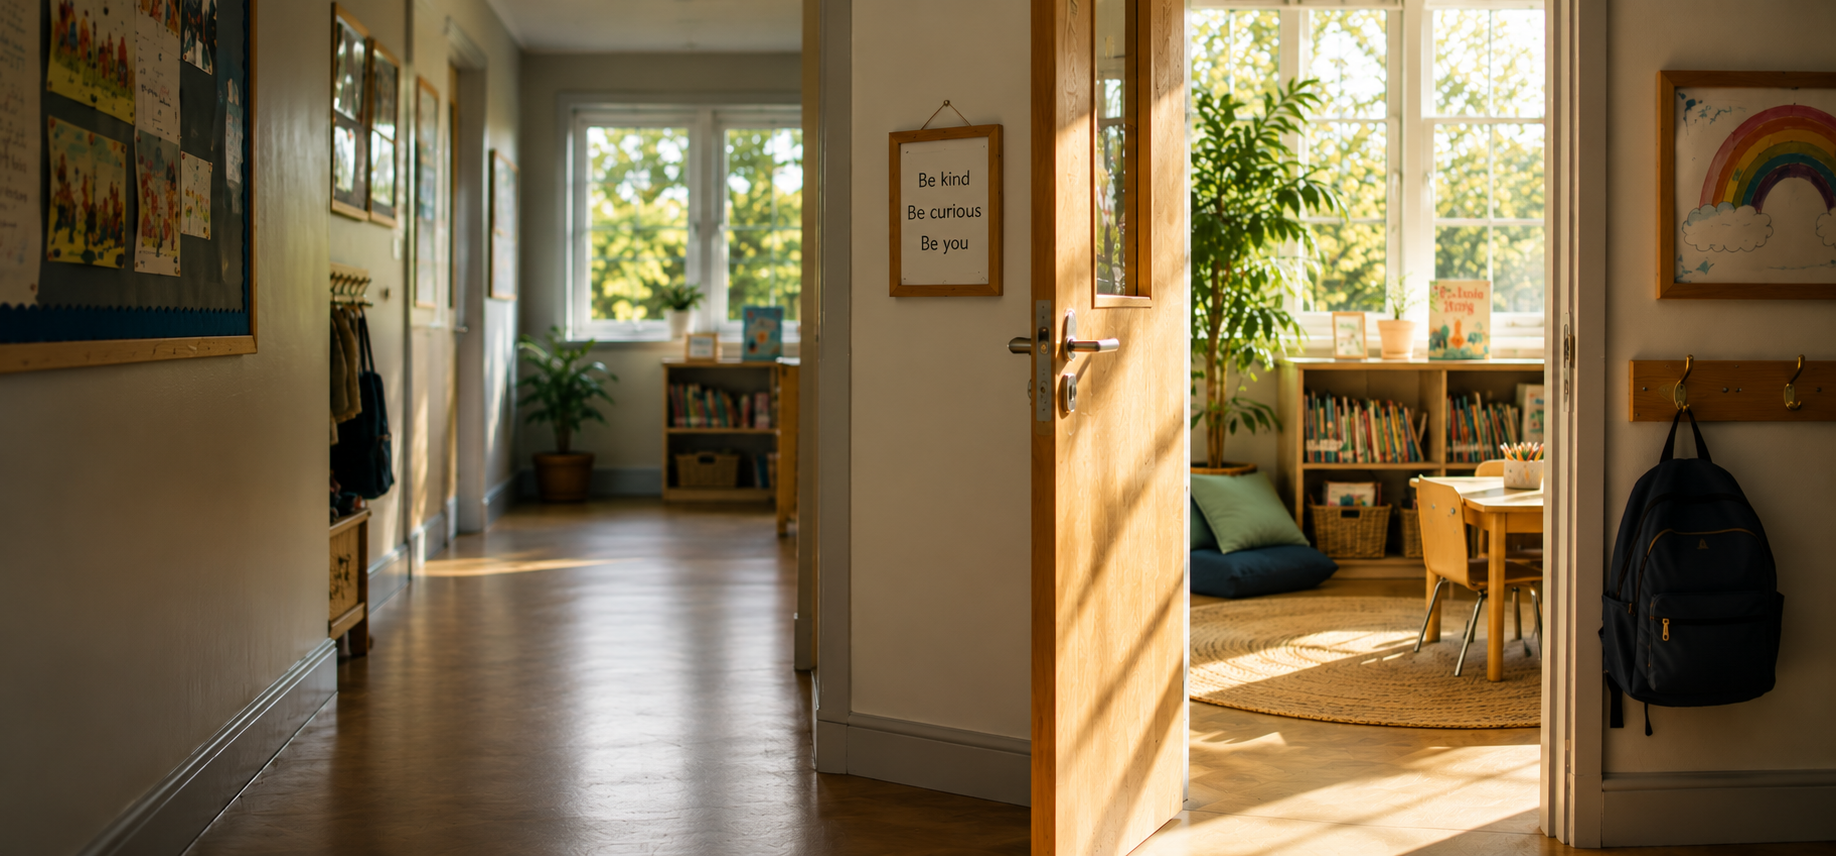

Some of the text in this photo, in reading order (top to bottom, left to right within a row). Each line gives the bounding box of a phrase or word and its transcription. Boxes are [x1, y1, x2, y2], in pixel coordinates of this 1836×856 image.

[918, 169, 970, 188] Be kind
[907, 203, 982, 220] Be curious
[921, 235, 968, 255] Be you
